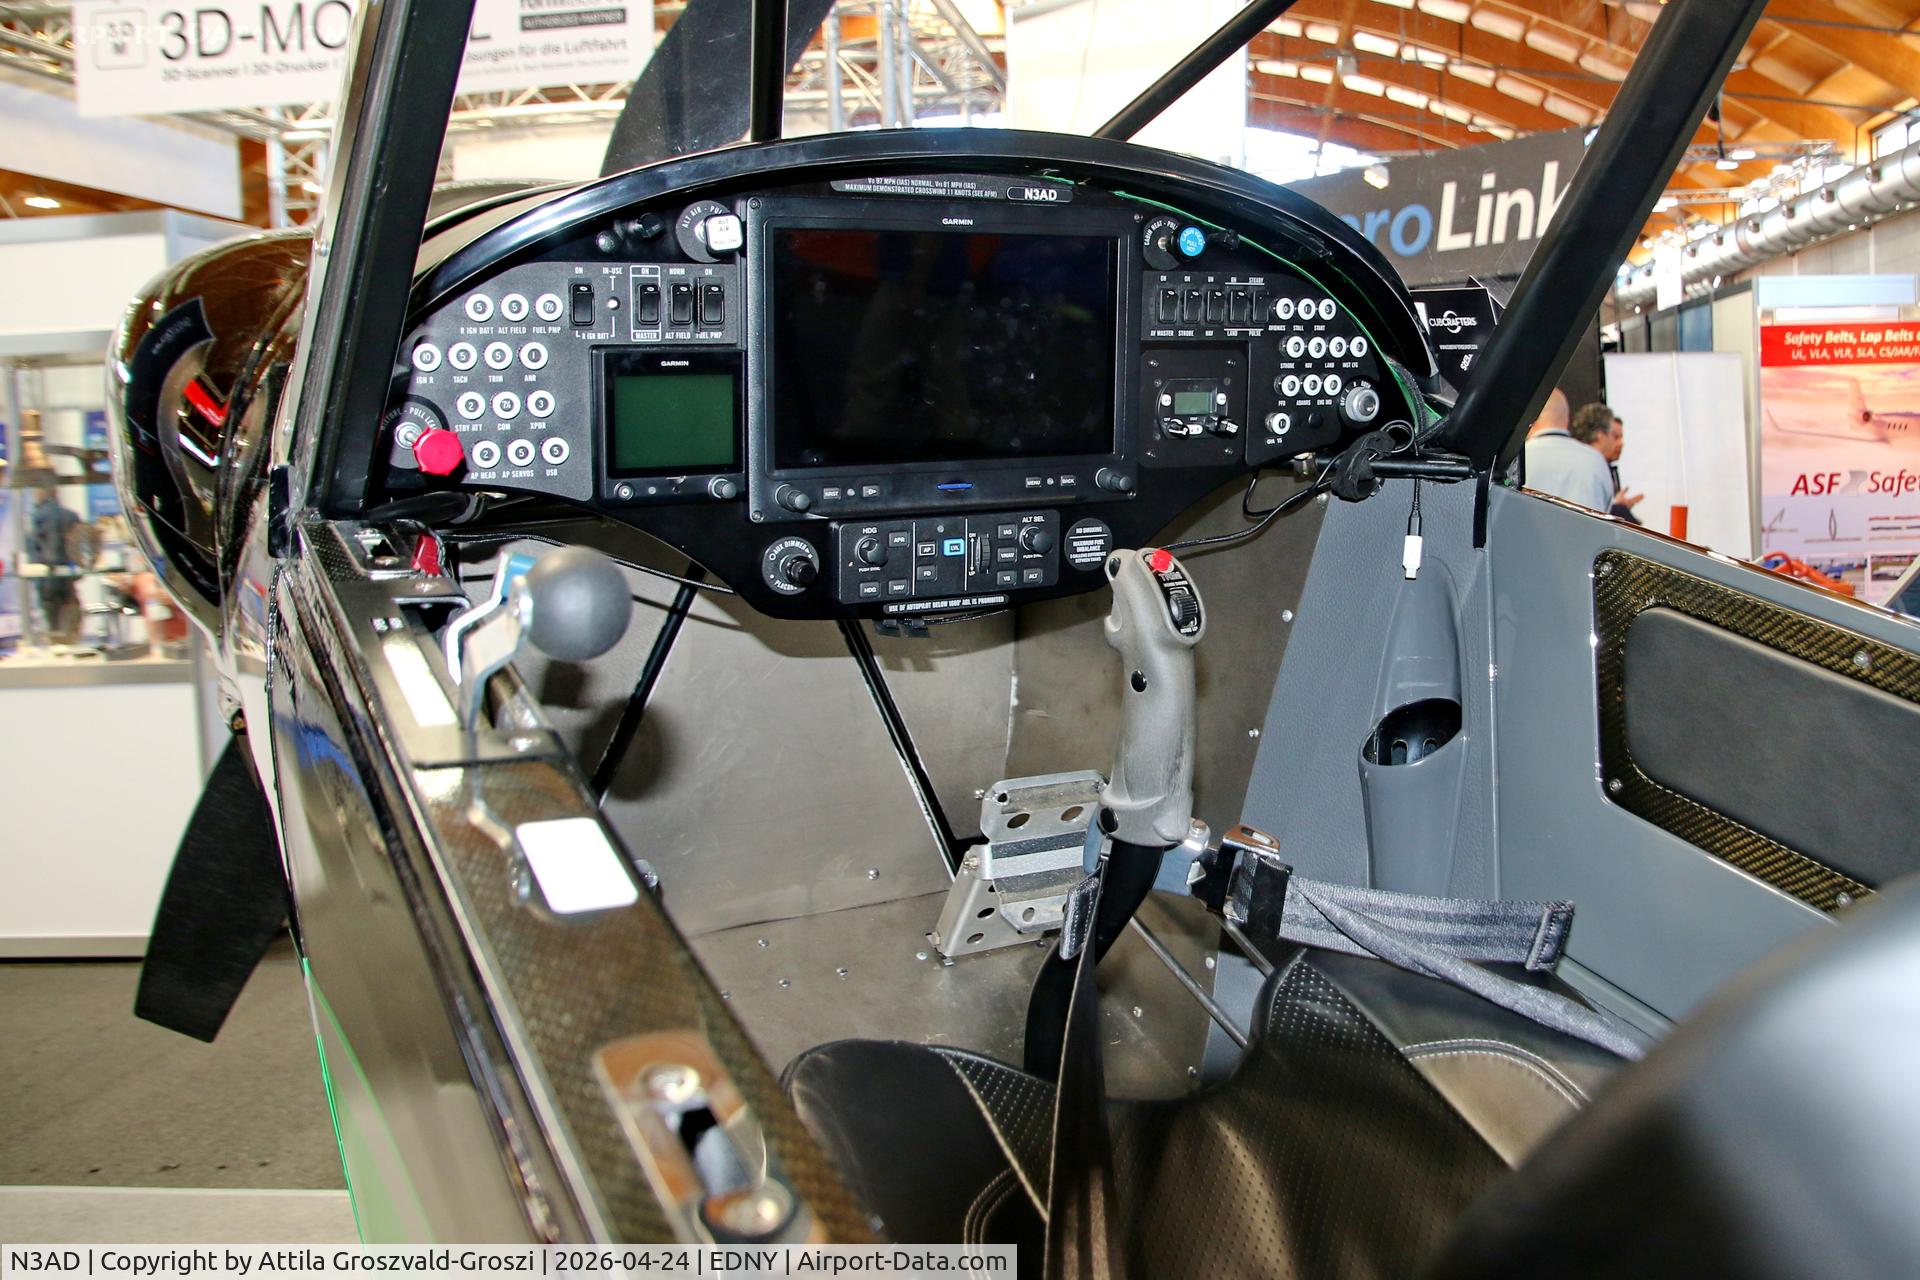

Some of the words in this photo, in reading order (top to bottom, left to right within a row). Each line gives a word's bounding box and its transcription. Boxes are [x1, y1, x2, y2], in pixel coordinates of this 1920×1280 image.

[541, 41, 561, 55] die
[565, 38, 628, 54] Luftfahrt
[872, 184, 915, 194] DEMONSTRATED
[915, 187, 947, 196] CROSSWIND
[954, 189, 972, 197] KNOTS
[1024, 188, 1058, 201] N3AD
[942, 218, 973, 226] GARMIN
[602, 267, 623, 275] IN-USE
[1428, 317, 1478, 327] CUBCRAFTERS
[466, 327, 478, 335] IGN
[479, 326, 494, 335] BATT
[498, 326, 509, 335] ALT
[510, 326, 527, 335] FIELD
[532, 326, 547, 334] FUEL
[548, 326, 561, 334] PMP
[665, 332, 675, 340] ALT
[675, 332, 691, 340] FIELD
[710, 332, 723, 340] PMP
[1784, 331, 1823, 347] Safety
[1825, 330, 1857, 345] Belts,
[1860, 329, 1882, 345] Lap
[1884, 328, 1914, 343] Belts
[416, 376, 428, 385] IGN
[453, 376, 468, 384] TACH
[488, 375, 503, 383] TRIM
[409, 407, 426, 420] PULL
[454, 424, 470, 432] STBY
[472, 423, 482, 431] ATT
[497, 423, 511, 431] COM
[530, 422, 546, 430] XPDR
[471, 472, 480, 480] AP
[481, 471, 497, 479] HEAD
[502, 471, 511, 479] AP
[512, 469, 534, 478] SERVOS
[1790, 472, 1841, 497] ASF
[1867, 468, 1920, 498] Safe
[772, 544, 785, 555] AUX
[784, 540, 808, 551] DIMMER
[906, 602, 931, 611] AUTOPILOT
[932, 601, 948, 609] BELOW
[978, 596, 1004, 604] PROHIBITED
